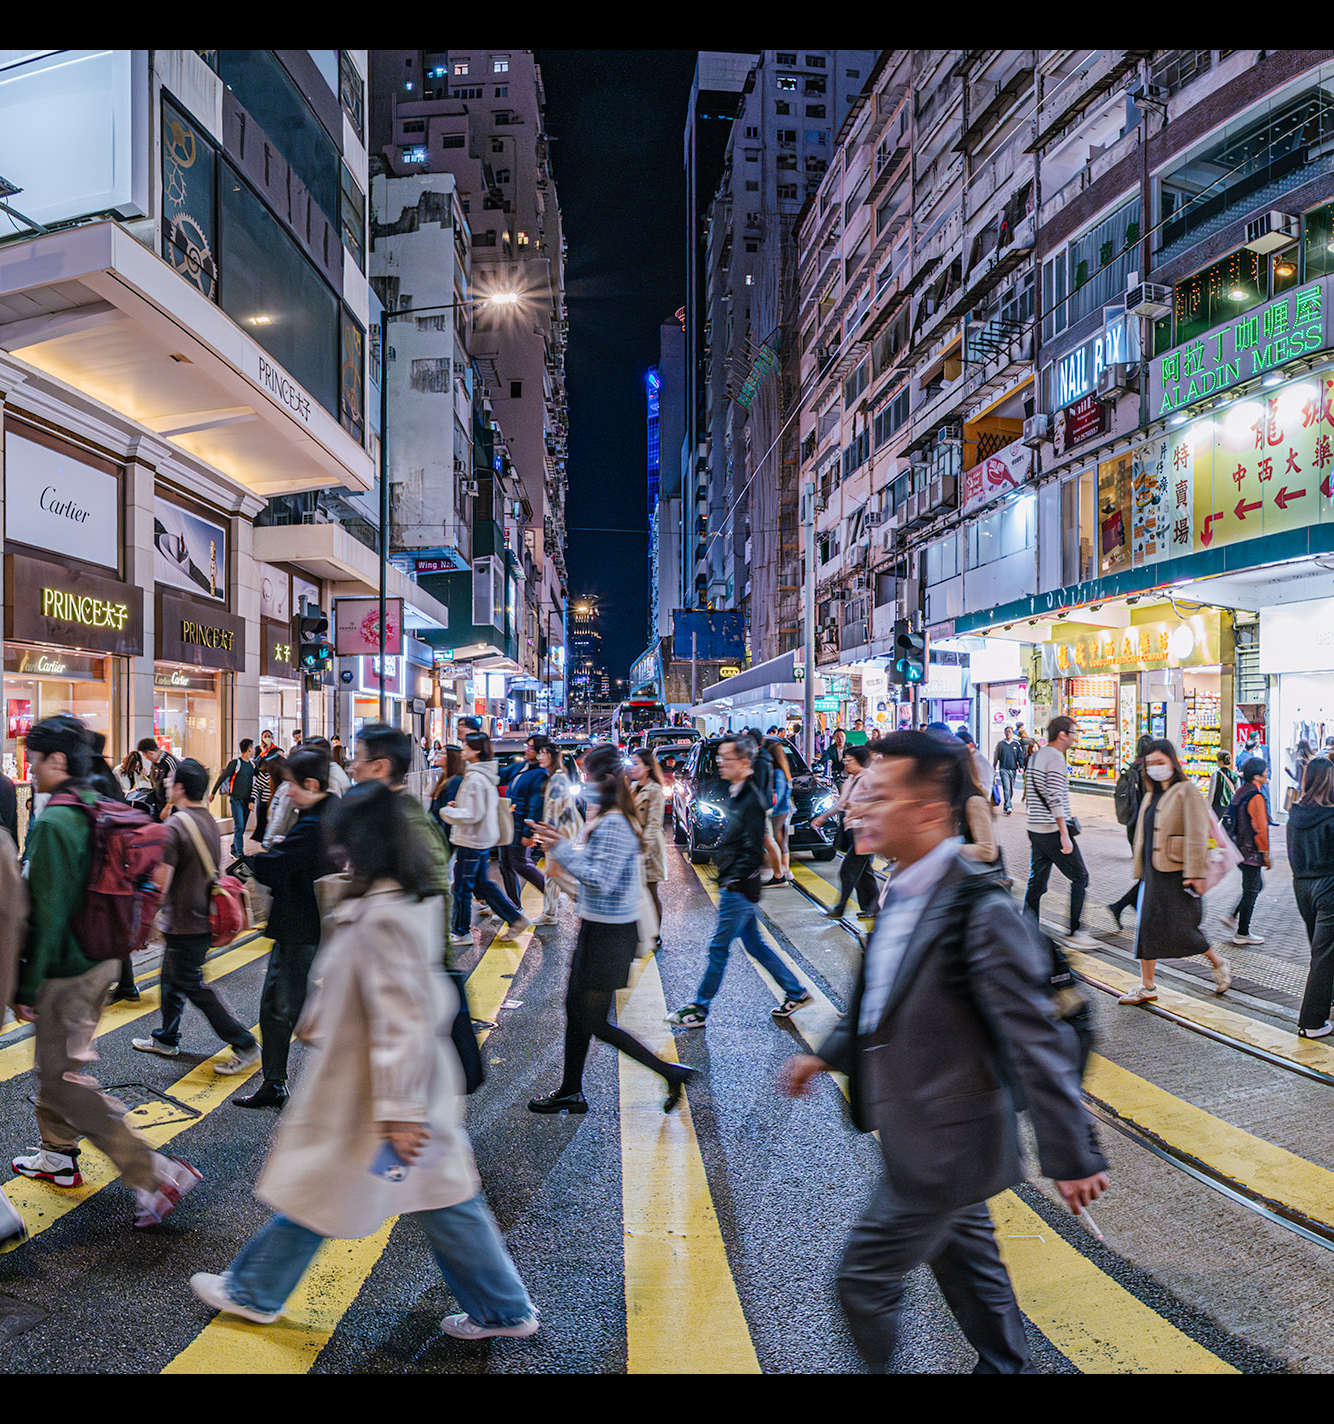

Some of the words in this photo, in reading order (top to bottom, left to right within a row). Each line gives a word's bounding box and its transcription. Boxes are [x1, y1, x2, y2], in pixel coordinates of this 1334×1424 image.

[1161, 285, 1323, 388] 阿拉丁咖喱屋
[259, 356, 311, 422] PRINCE太子
[1061, 347, 1087, 406] NAIL
[1159, 357, 1240, 415] ALADIN
[1251, 323, 1323, 374] MESS
[39, 486, 90, 523] Cartier
[1173, 443, 1190, 545] 特賣場
[419, 561, 437, 570] Wing
[43, 587, 128, 630] PRINCE太子
[183, 621, 234, 651] PRINCE太子
[38, 656, 66, 674] Cartier
